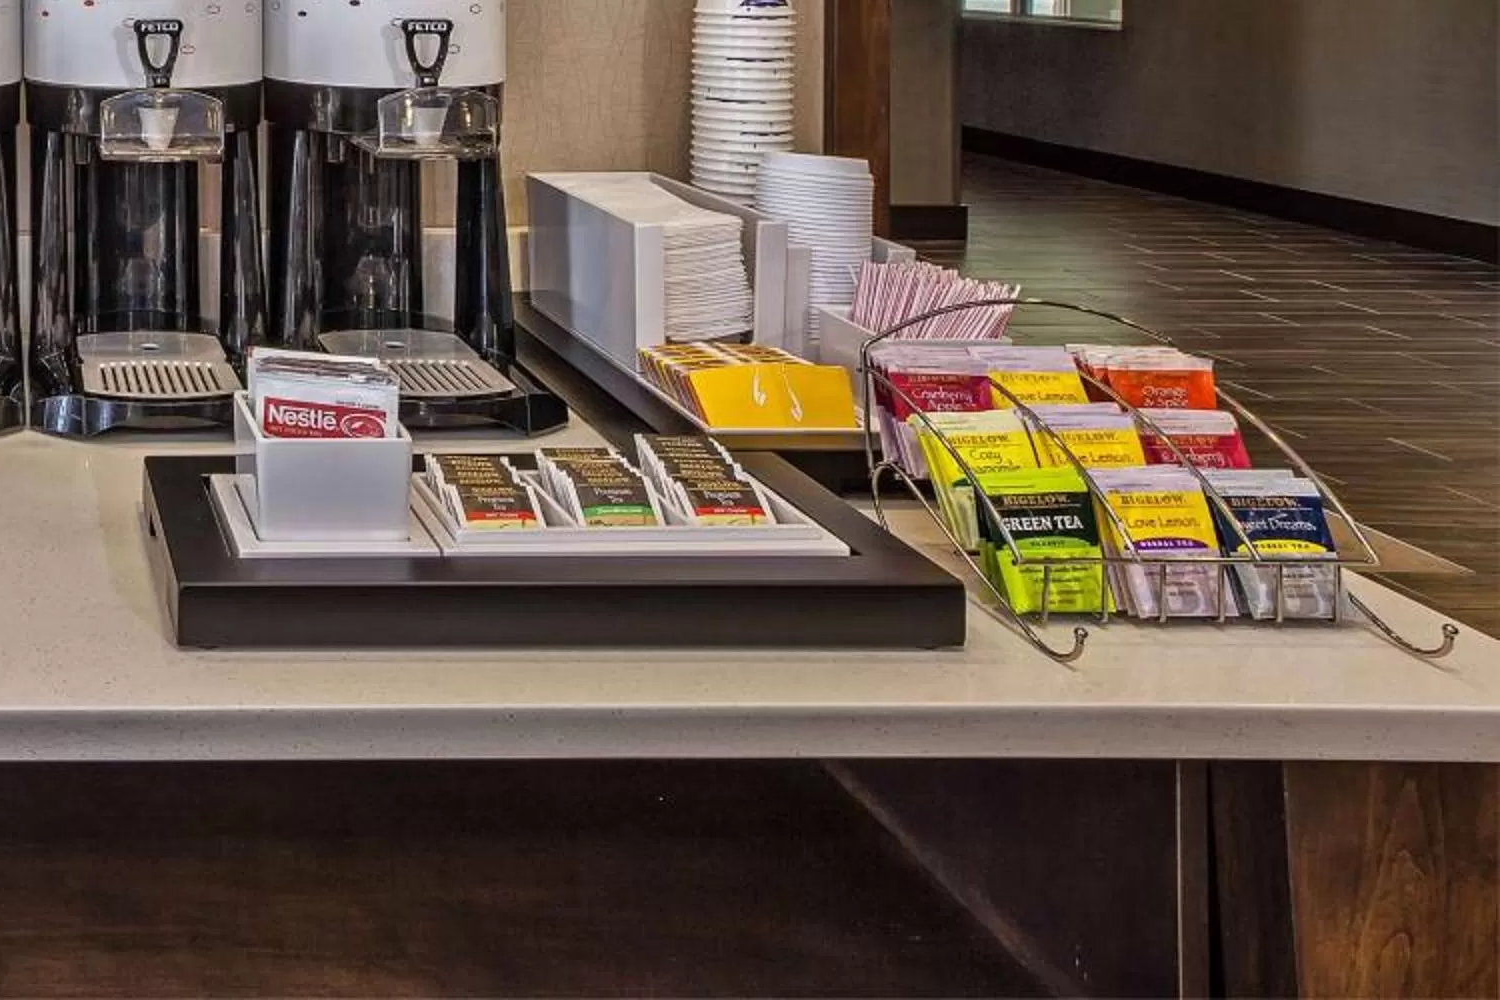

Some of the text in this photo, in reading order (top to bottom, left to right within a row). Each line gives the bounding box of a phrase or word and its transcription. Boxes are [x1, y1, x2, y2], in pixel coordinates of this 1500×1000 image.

[140, 21, 180, 33] FETCO
[407, 21, 448, 32] FETCO
[1002, 494, 1068, 506] BIGELOW
[1000, 515, 1084, 532] GREEN TEA
